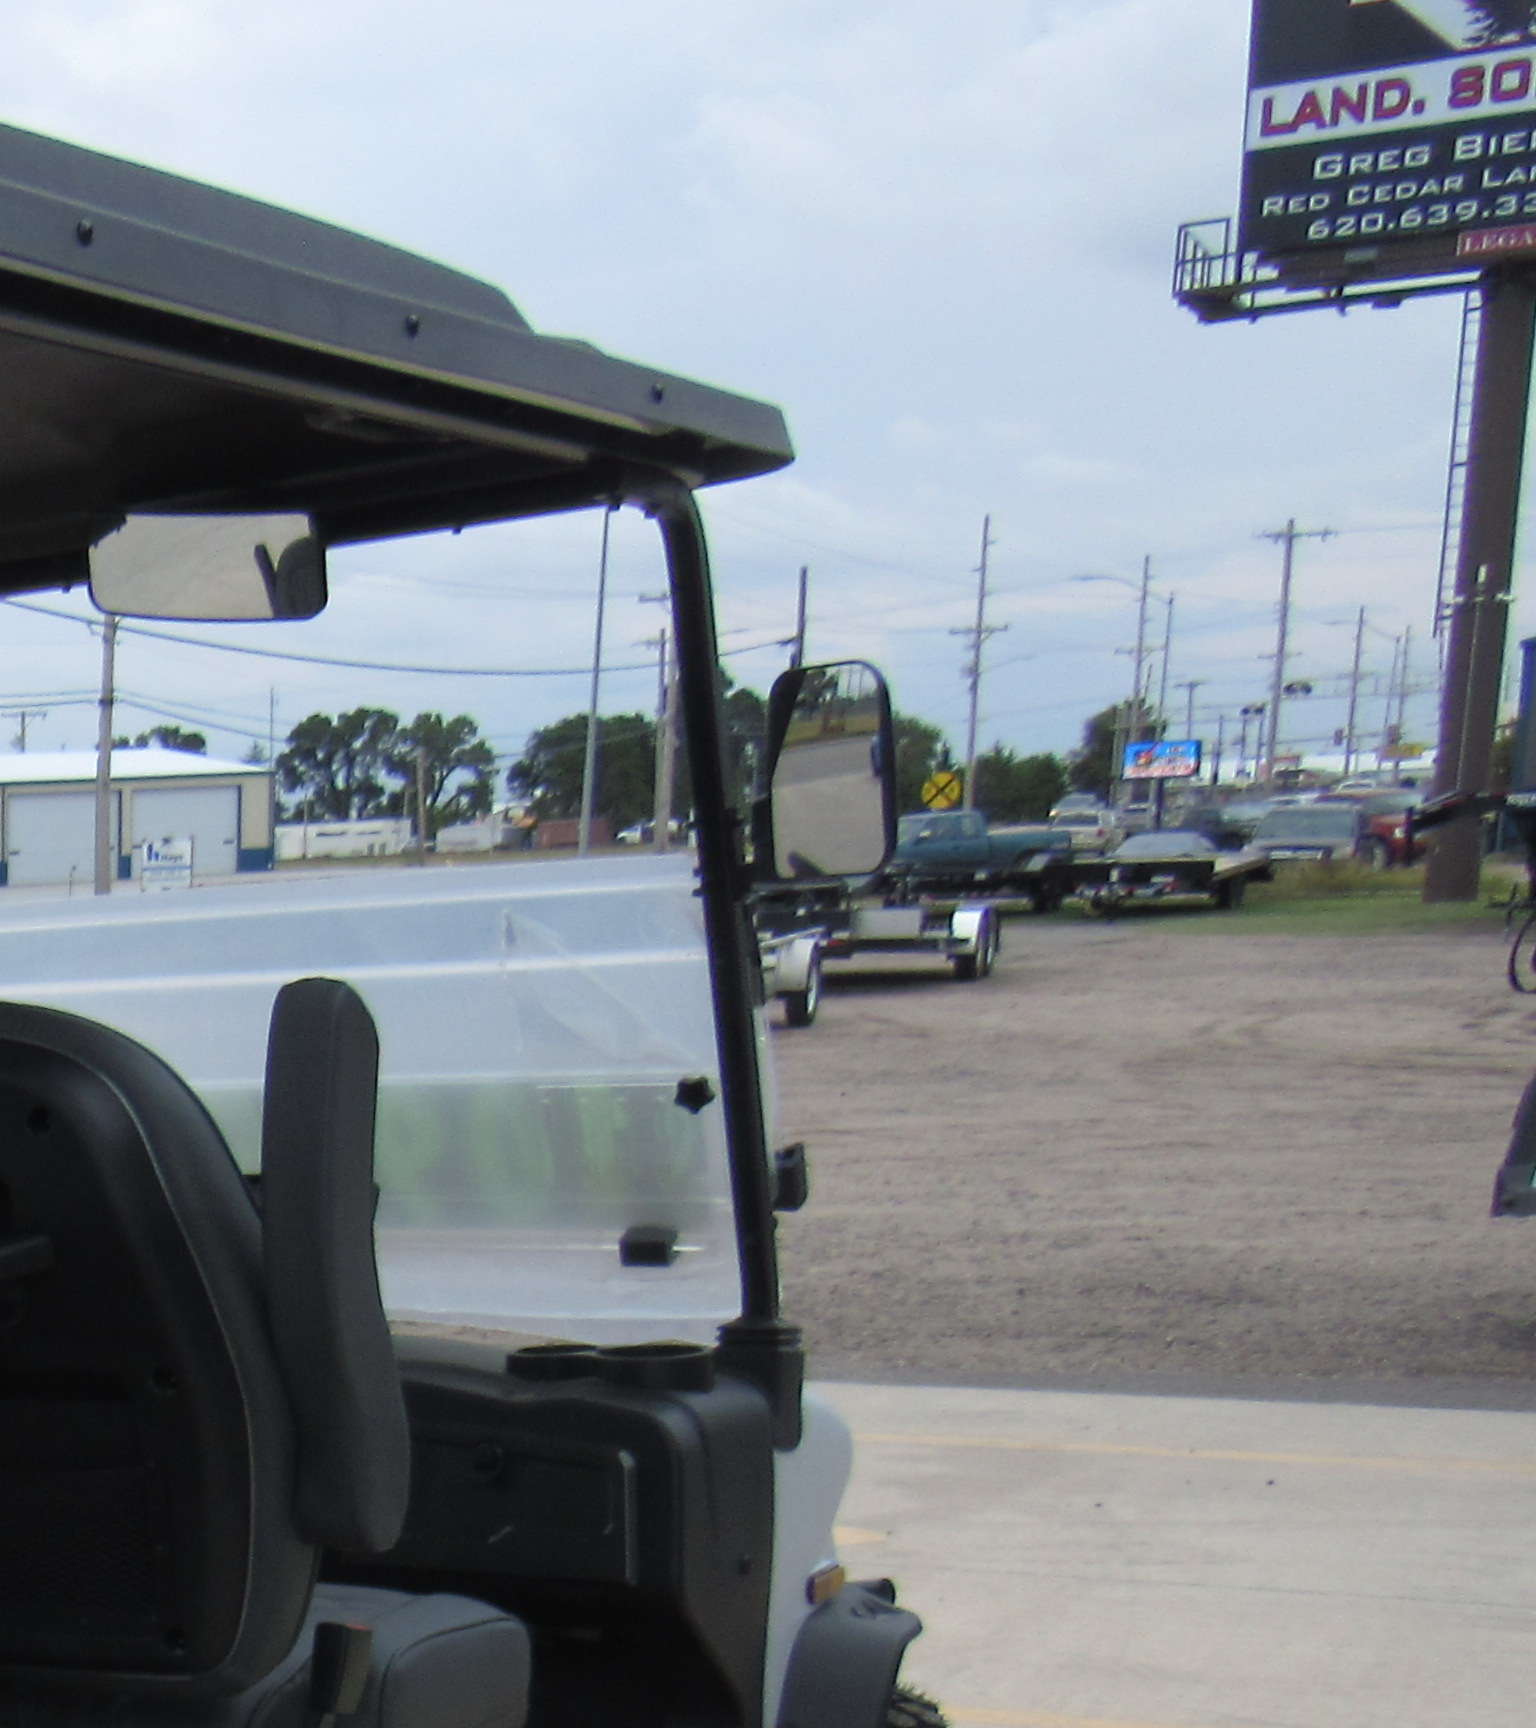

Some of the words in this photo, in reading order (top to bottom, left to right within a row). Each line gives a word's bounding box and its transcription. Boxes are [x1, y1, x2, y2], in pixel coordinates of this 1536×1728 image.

[1260, 78, 1425, 137] LAND.
[1313, 145, 1431, 180] GREG
[1261, 193, 1330, 217] RED
[1346, 174, 1465, 206] CEDAR
